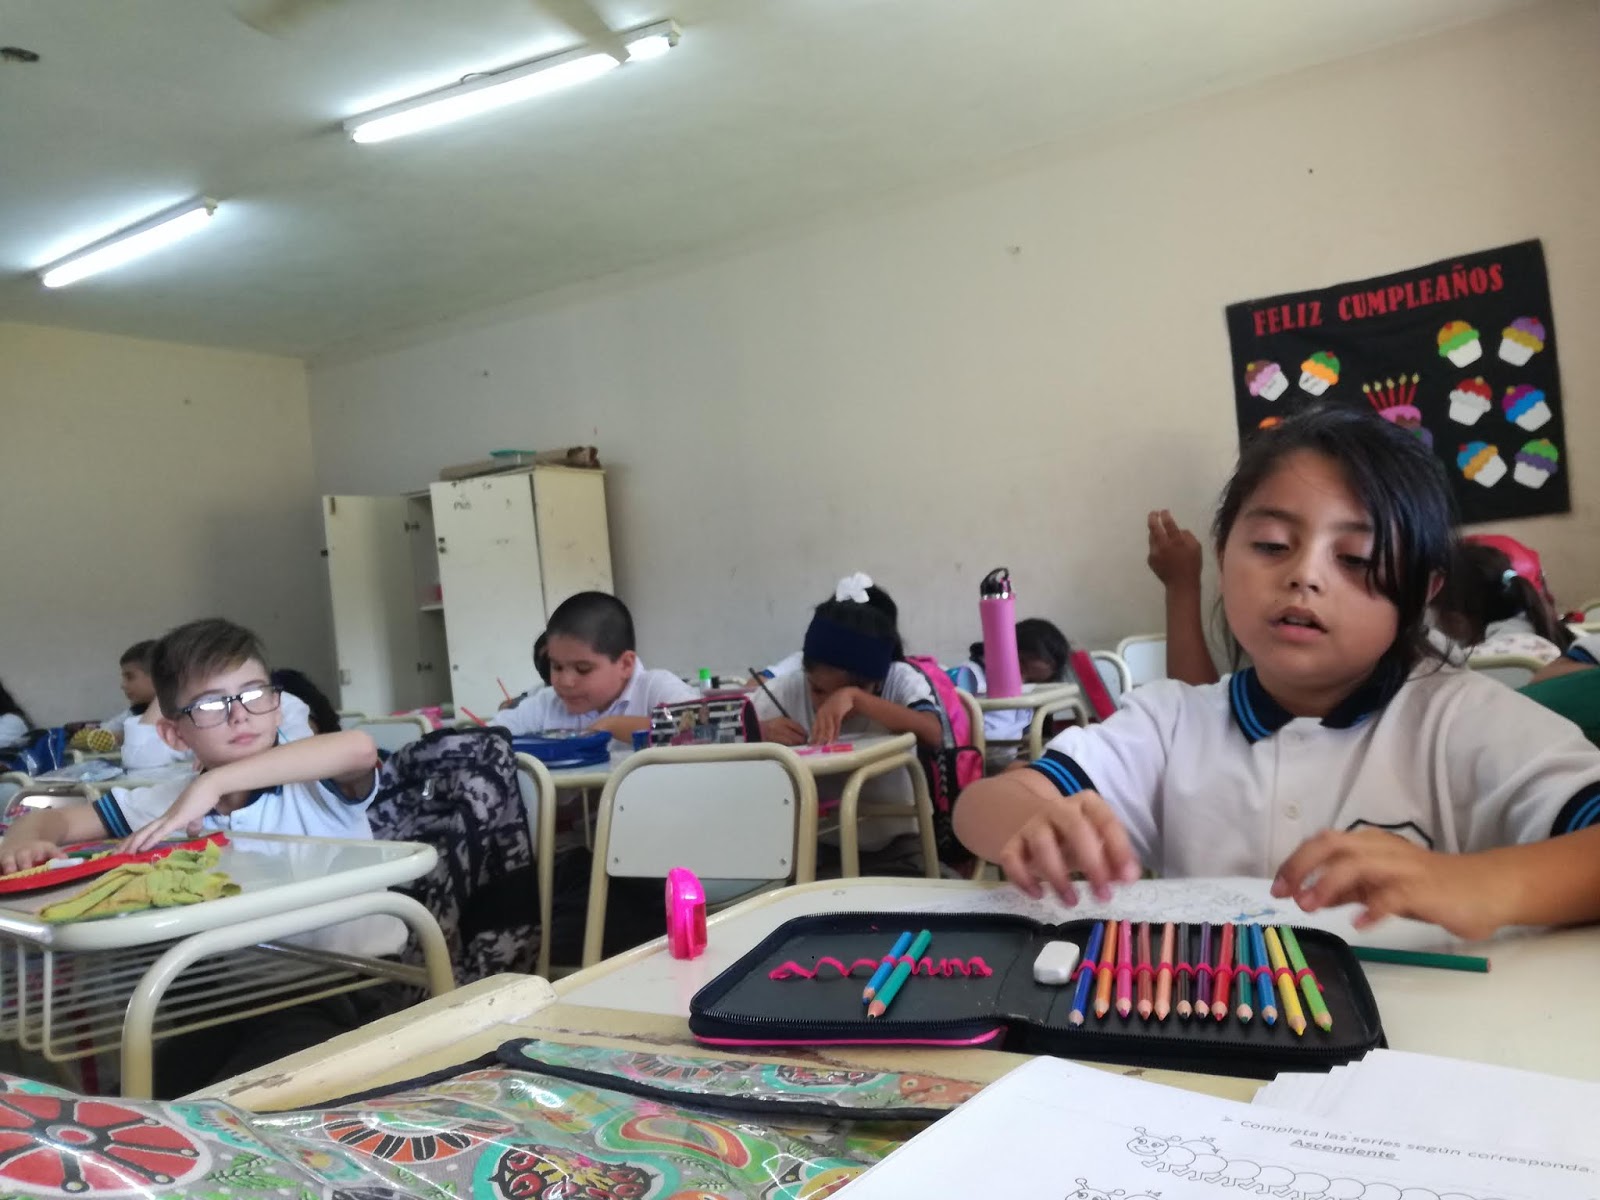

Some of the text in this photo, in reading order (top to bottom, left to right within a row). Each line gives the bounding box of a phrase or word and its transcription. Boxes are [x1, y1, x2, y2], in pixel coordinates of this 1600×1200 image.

[1253, 264, 1504, 336] FELIZ CUMPLEAÑOS
[1240, 1120, 1319, 1138] Completa
[1324, 1131, 1347, 1142] las
[1353, 1135, 1400, 1149] series
[1407, 1143, 1461, 1156] según
[1291, 1139, 1397, 1160] Ascendente
